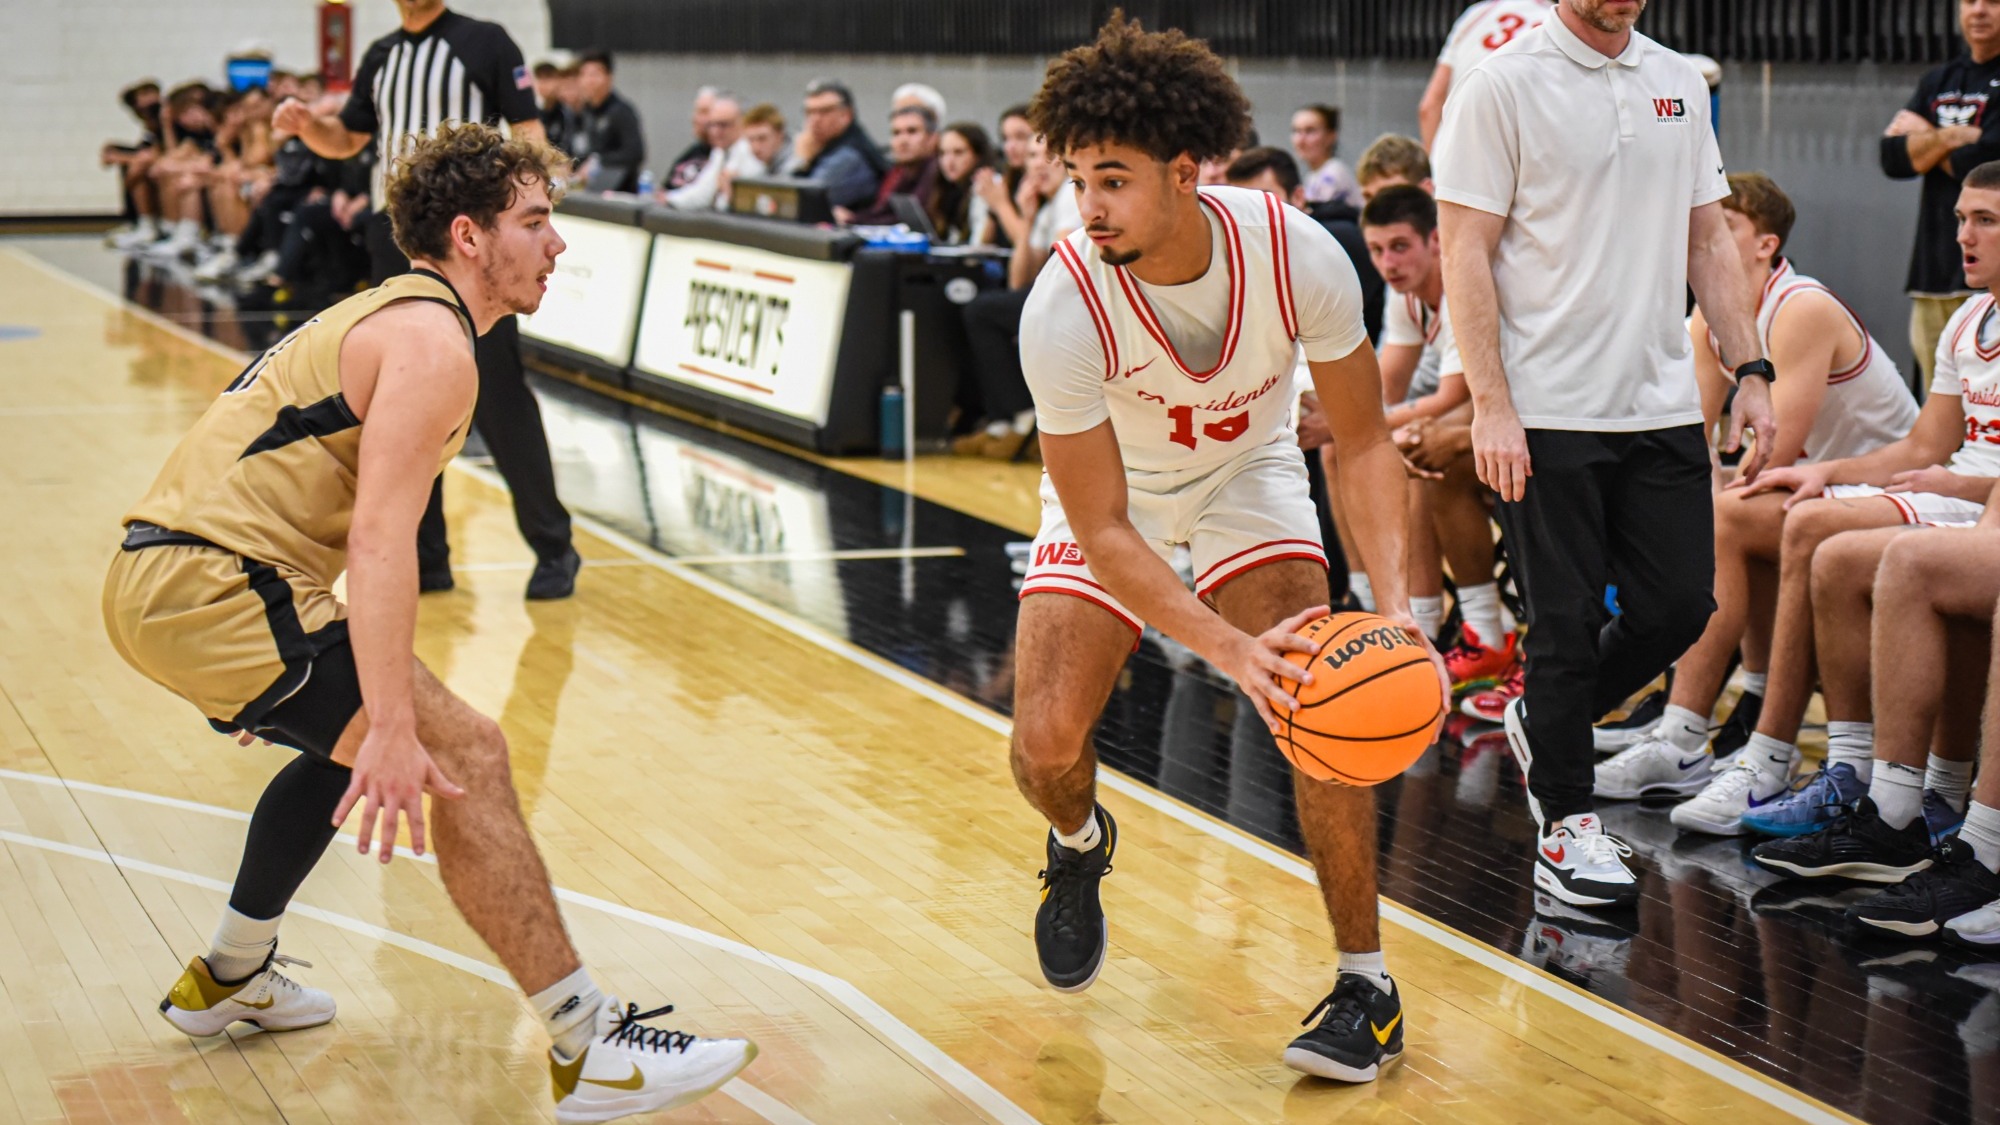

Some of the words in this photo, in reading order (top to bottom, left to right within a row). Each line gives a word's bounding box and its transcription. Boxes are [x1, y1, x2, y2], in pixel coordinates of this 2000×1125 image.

[1481, 12, 1543, 51] 3
[1652, 98, 1686, 117] W&J
[1137, 374, 1281, 412] idents
[1035, 542, 1087, 567] W&J
[1323, 625, 1420, 670] Wilson
